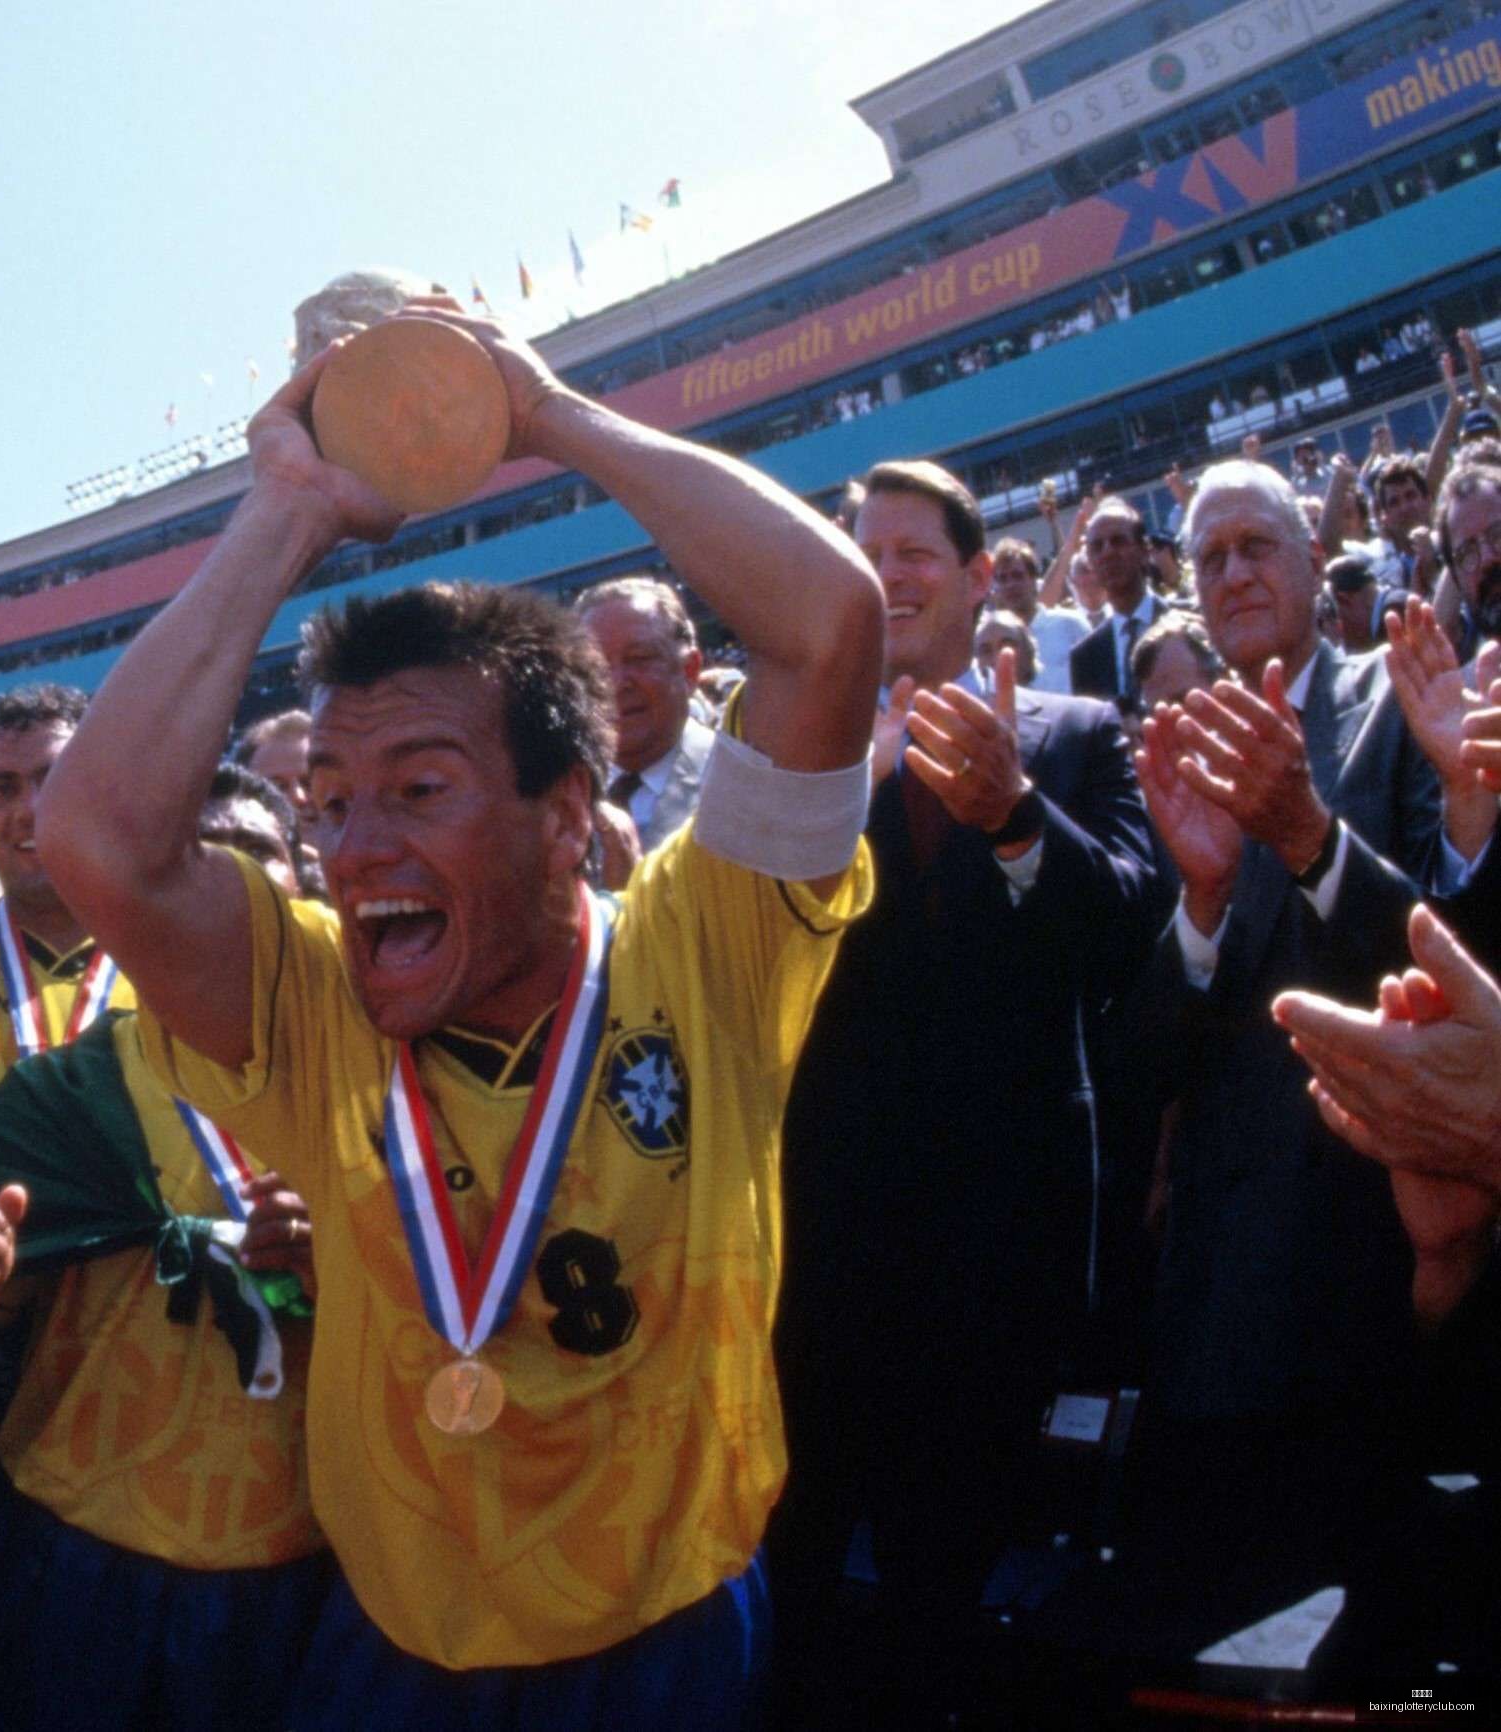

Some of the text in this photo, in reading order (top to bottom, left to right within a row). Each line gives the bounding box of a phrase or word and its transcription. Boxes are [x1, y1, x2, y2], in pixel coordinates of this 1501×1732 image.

[1011, 79, 1140, 156] ROSE
[1365, 39, 1501, 129] making
[1100, 107, 1298, 257] XV
[681, 241, 1043, 408] fifteenth world cup
[536, 1228, 641, 1357] 8
